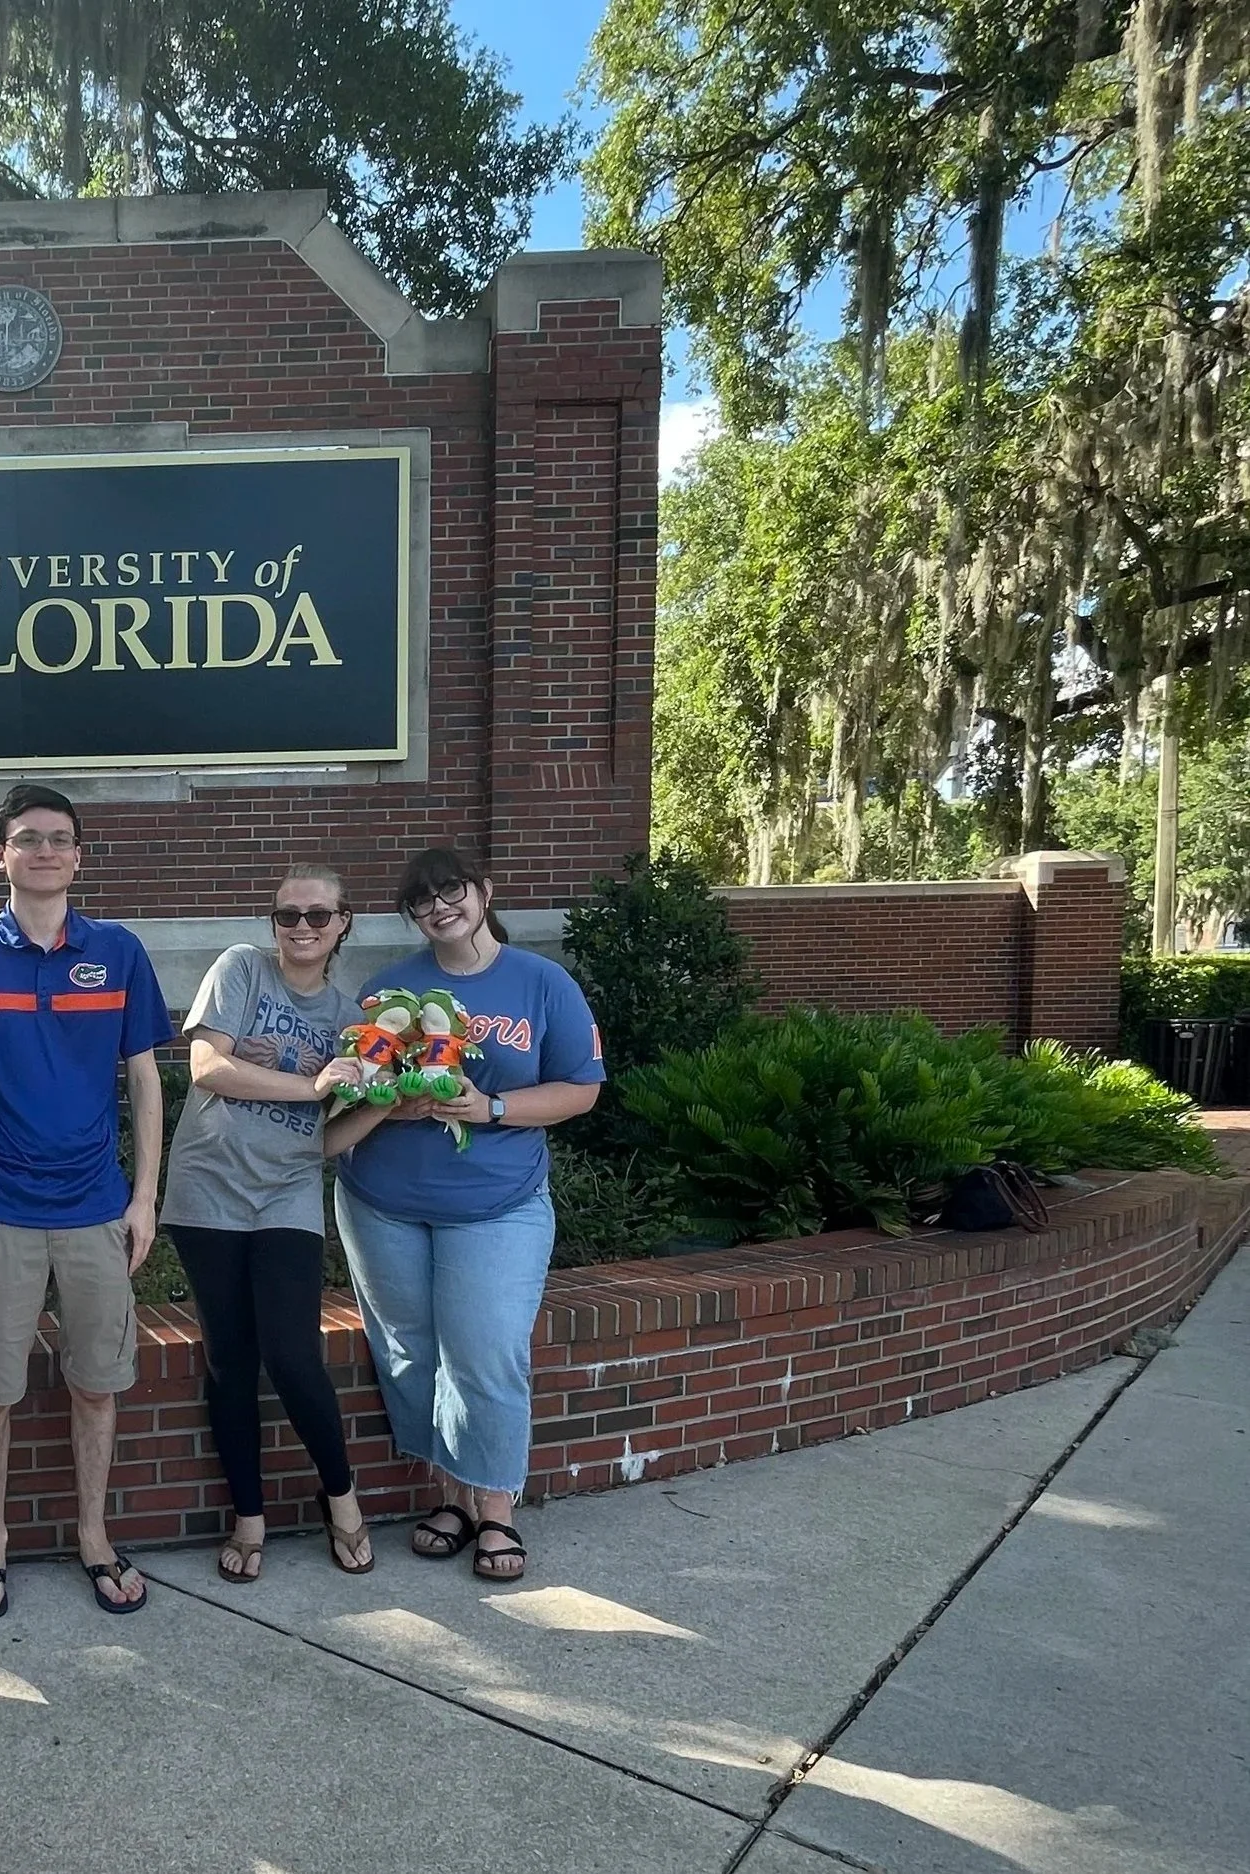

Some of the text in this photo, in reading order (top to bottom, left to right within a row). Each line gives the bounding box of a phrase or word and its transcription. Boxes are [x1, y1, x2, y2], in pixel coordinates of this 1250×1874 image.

[254, 544, 303, 598] of
[365, 1036, 392, 1061] F
[467, 1015, 532, 1052] ors
[426, 1039, 451, 1064] F
